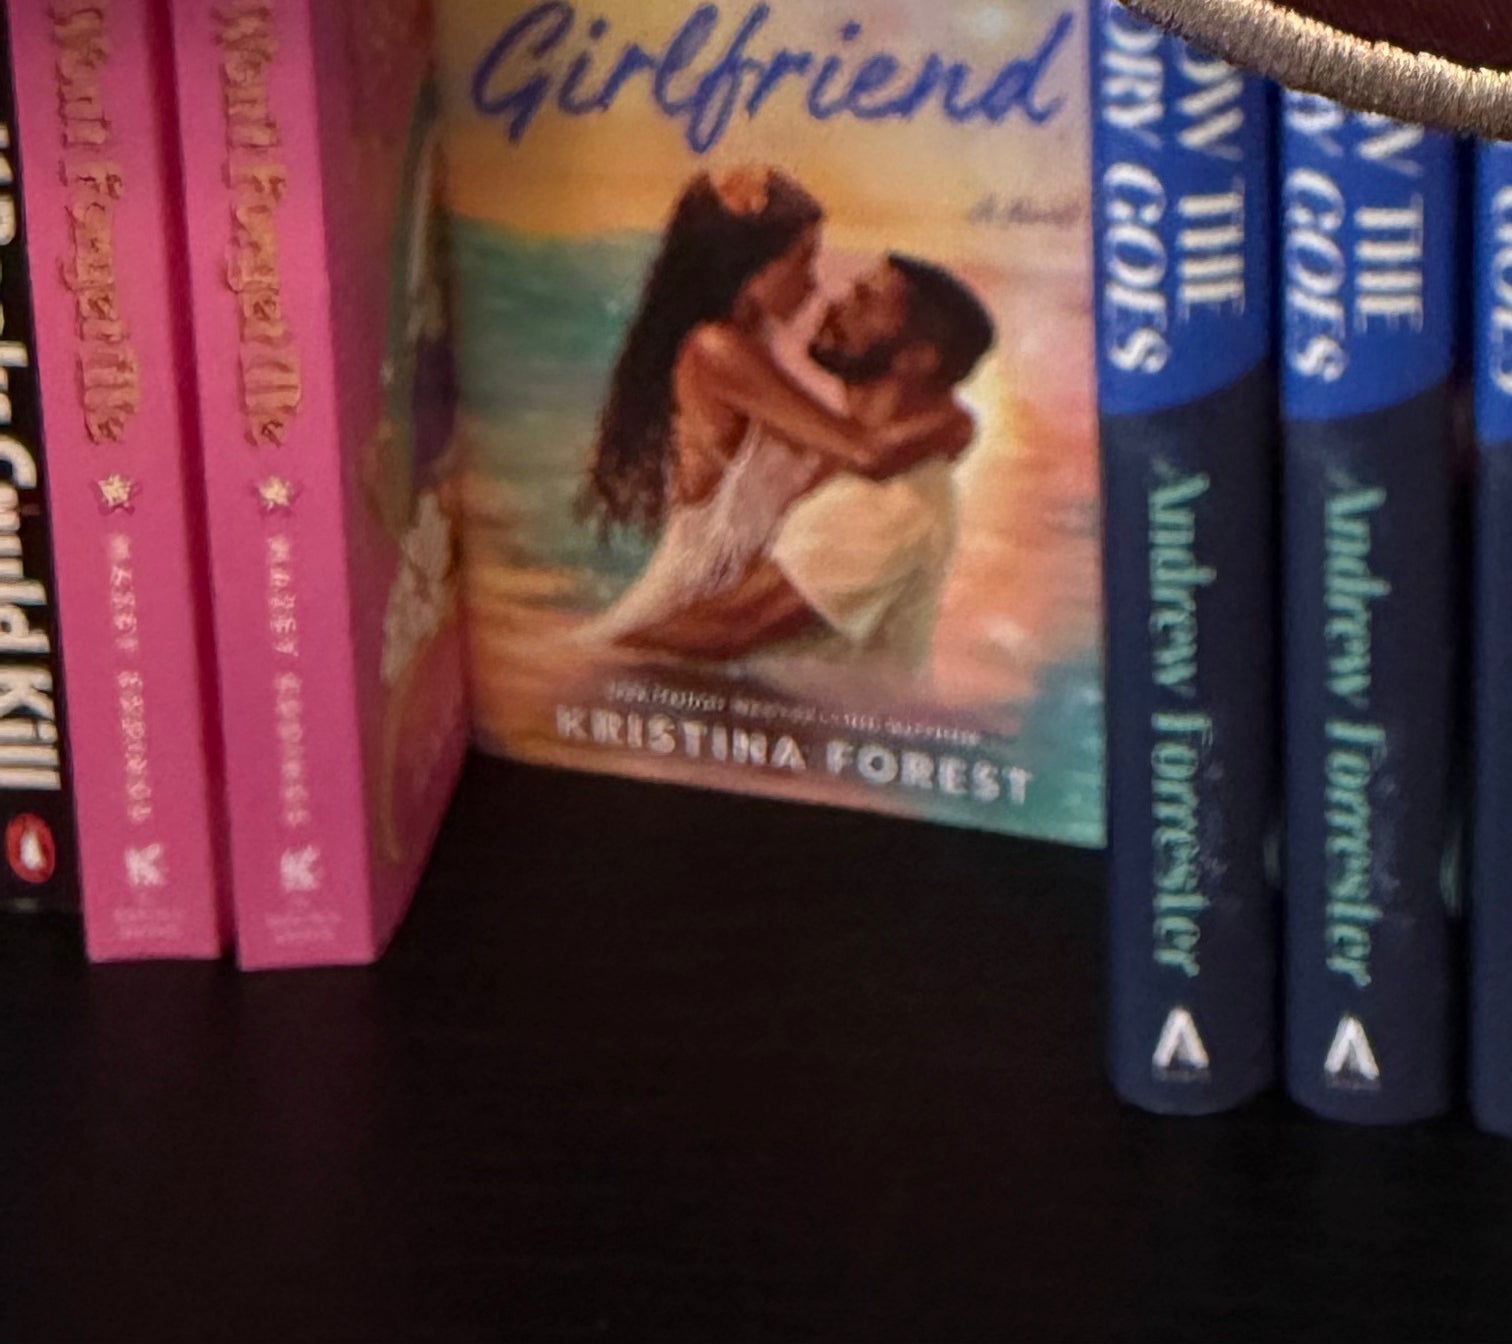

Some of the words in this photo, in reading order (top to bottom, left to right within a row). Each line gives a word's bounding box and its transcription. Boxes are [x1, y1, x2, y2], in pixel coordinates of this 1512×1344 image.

[223, 161, 289, 344] Forget
[1102, 161, 1172, 375] GOES
[1176, 176, 1246, 320] THE
[1285, 168, 1350, 382] GOES
[1354, 193, 1425, 333] THE
[1148, 459, 1217, 698] Andrew
[1324, 468, 1392, 707] Andrew
[0, 664, 62, 792] Kill
[556, 705, 806, 772] KRISTINA
[826, 740, 1034, 806] FOREST
[1151, 712, 1214, 977] Forrester
[1324, 721, 1388, 987] Forrester
